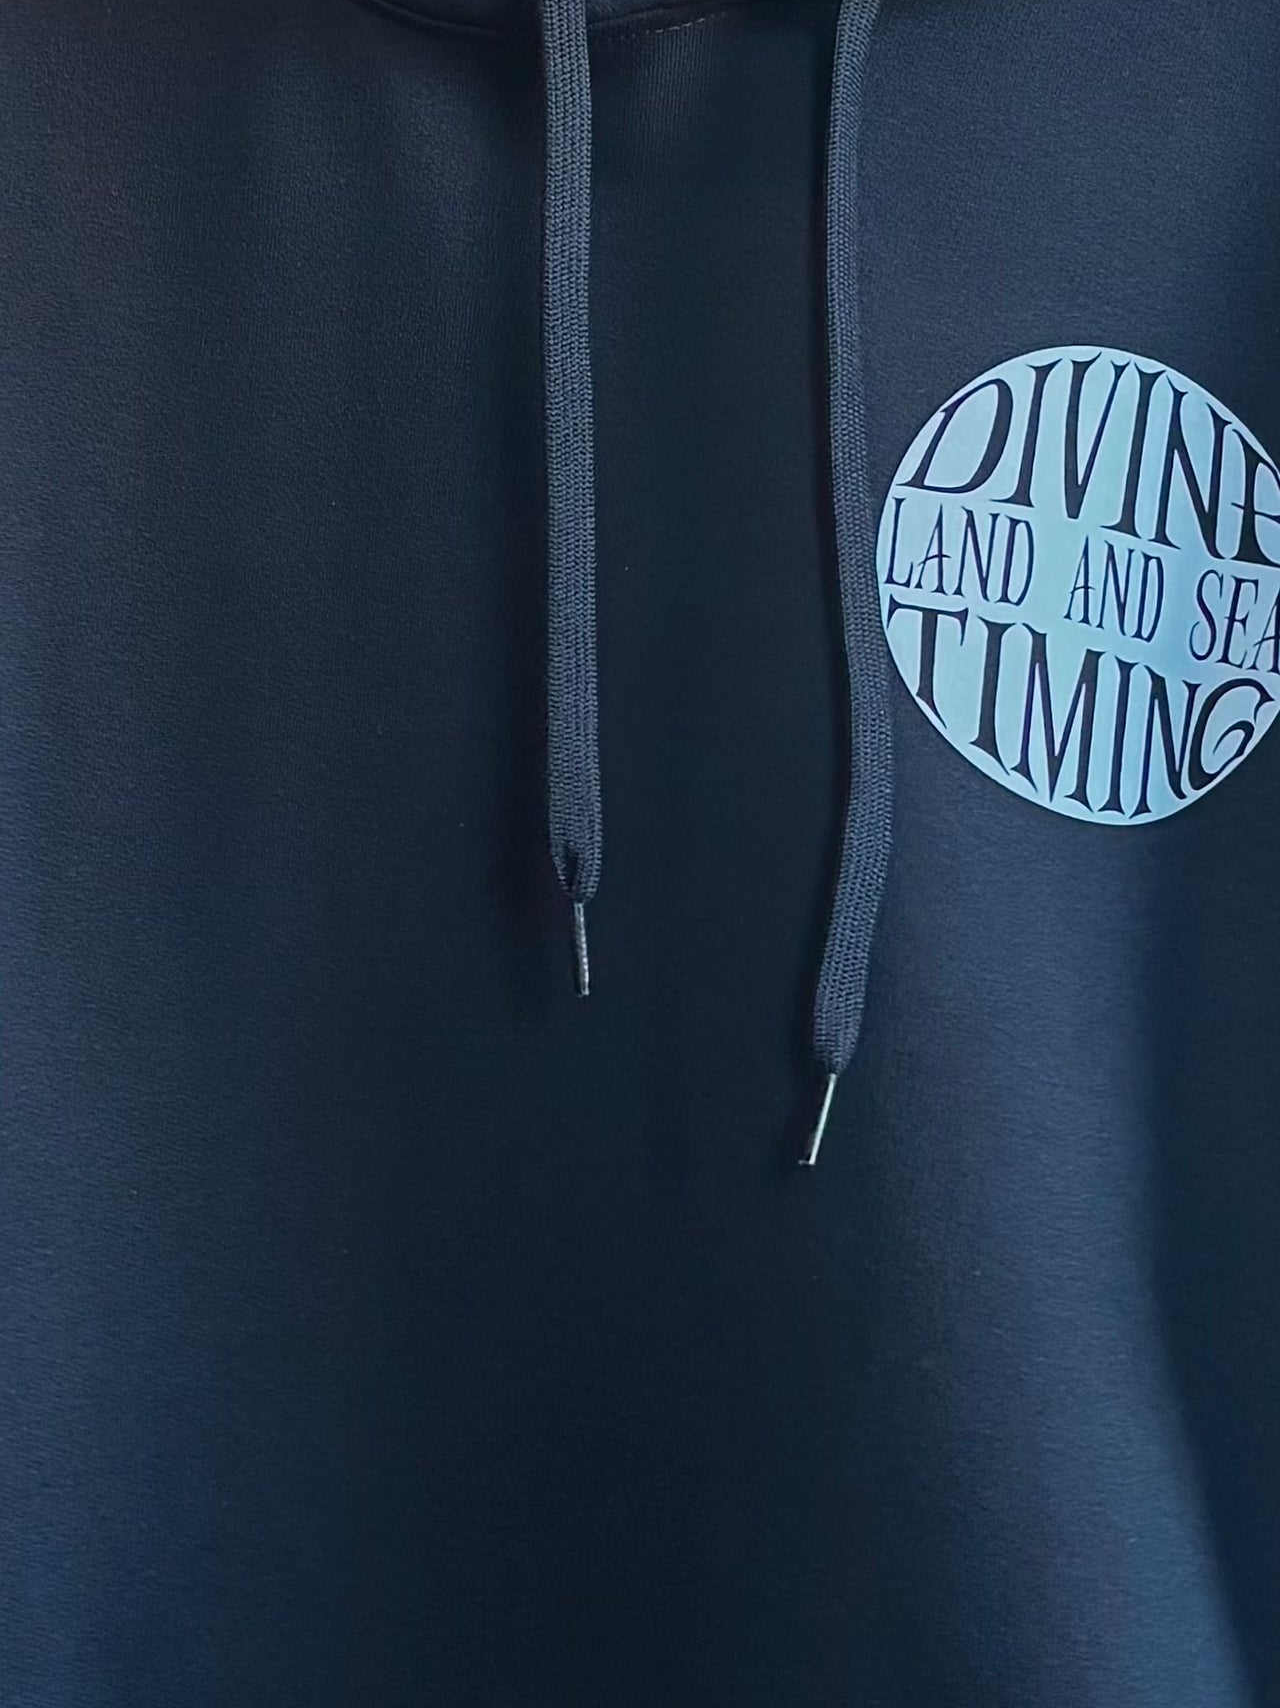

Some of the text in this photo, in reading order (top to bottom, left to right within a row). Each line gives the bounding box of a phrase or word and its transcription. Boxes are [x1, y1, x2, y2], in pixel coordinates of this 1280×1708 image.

[883, 496, 1035, 607] LAND
[1063, 535, 1165, 644] AND
[885, 593, 1276, 821] TIMING
